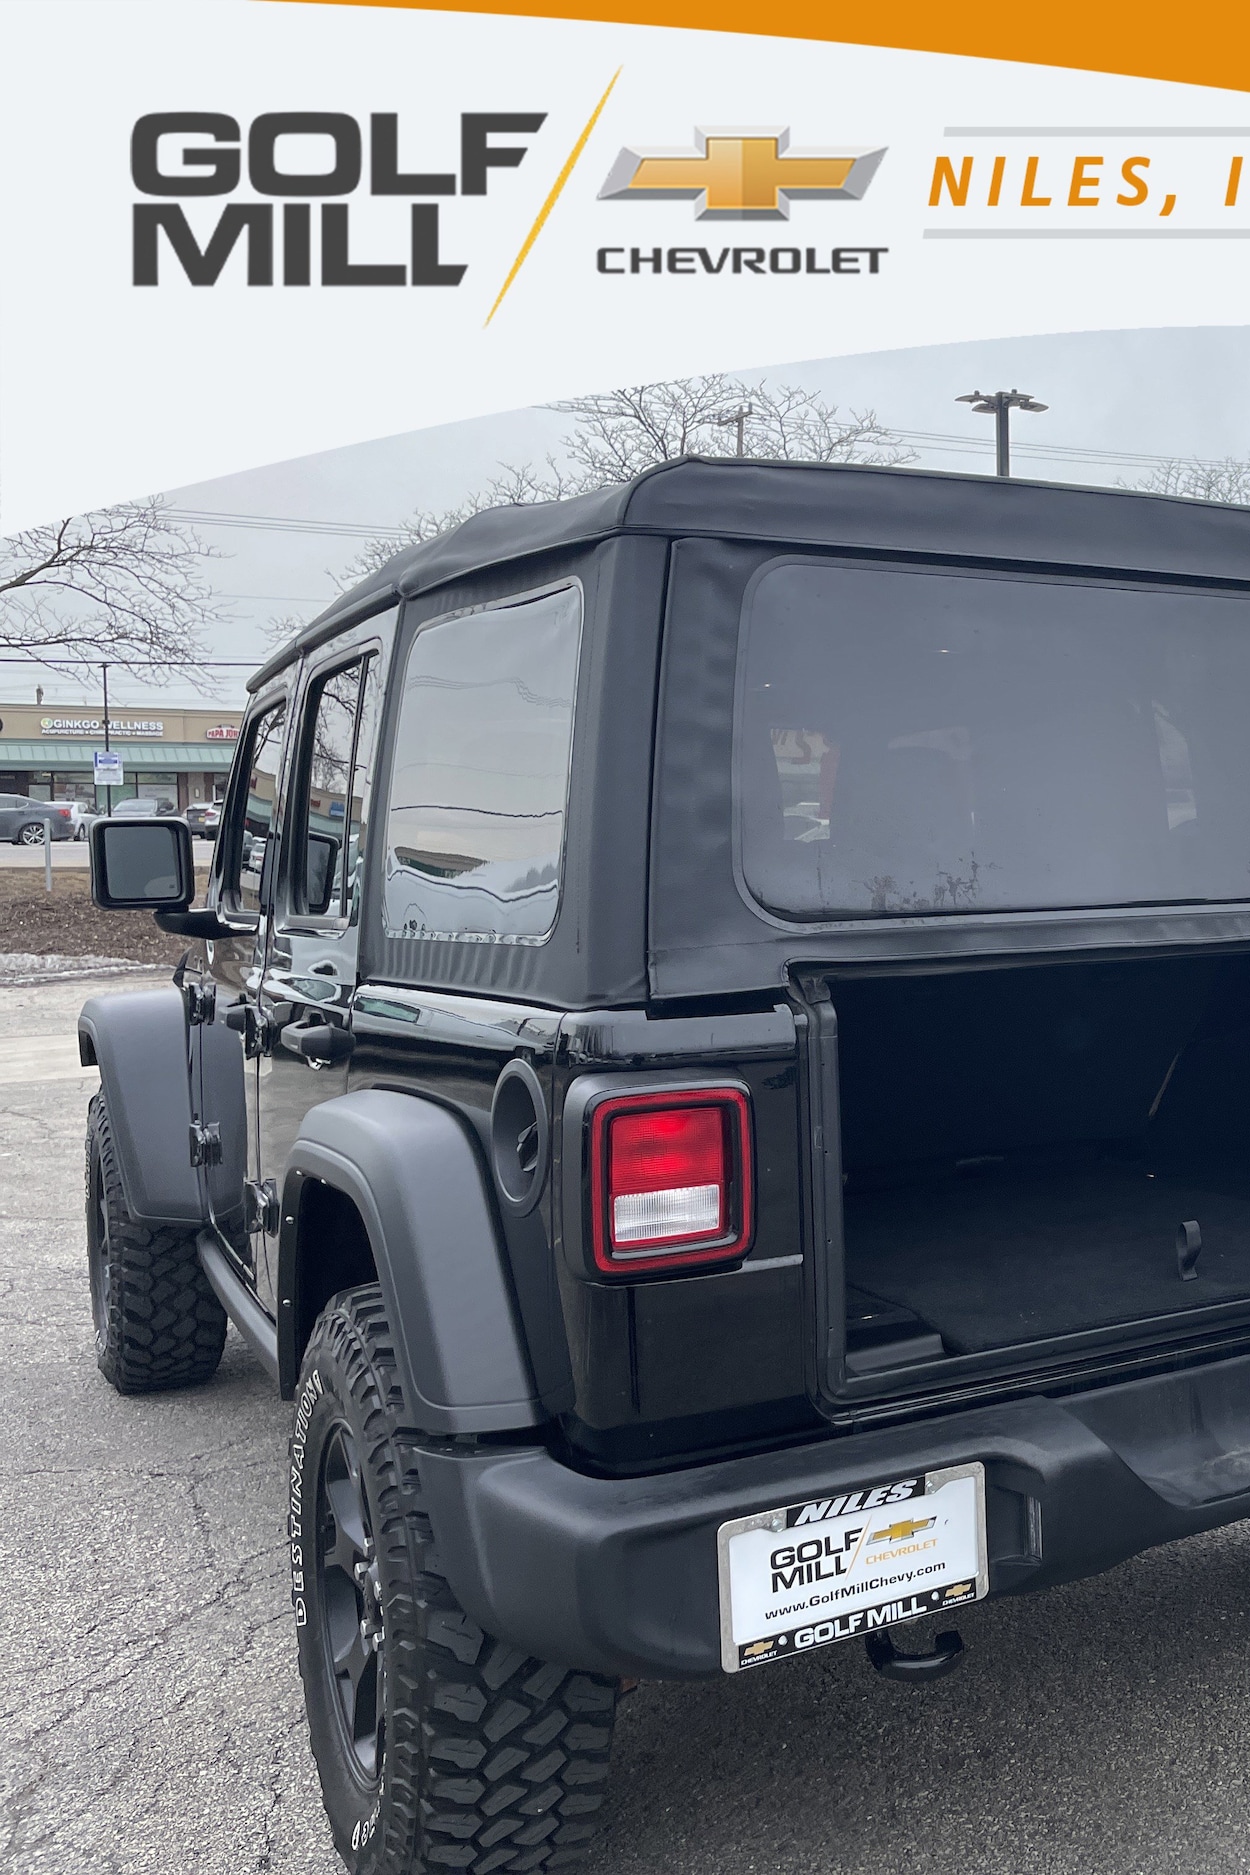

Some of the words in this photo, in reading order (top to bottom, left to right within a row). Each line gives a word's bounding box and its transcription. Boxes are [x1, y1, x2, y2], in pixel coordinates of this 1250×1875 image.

[53, 719, 100, 729] GINKGO
[208, 729, 225, 738] PAPA
[794, 1479, 918, 1527] NILES
[769, 1527, 863, 1571] GOLF
[865, 1537, 938, 1566] CHEVROLET
[764, 1560, 947, 1621] www.GolfMillChevy.com
[771, 1554, 848, 1594] MILL
[941, 1591, 976, 1607] CHEVROLET
[794, 1612, 866, 1650] GOLF
[866, 1596, 928, 1629] MILL
[740, 1649, 778, 1666] CHEVROLET
